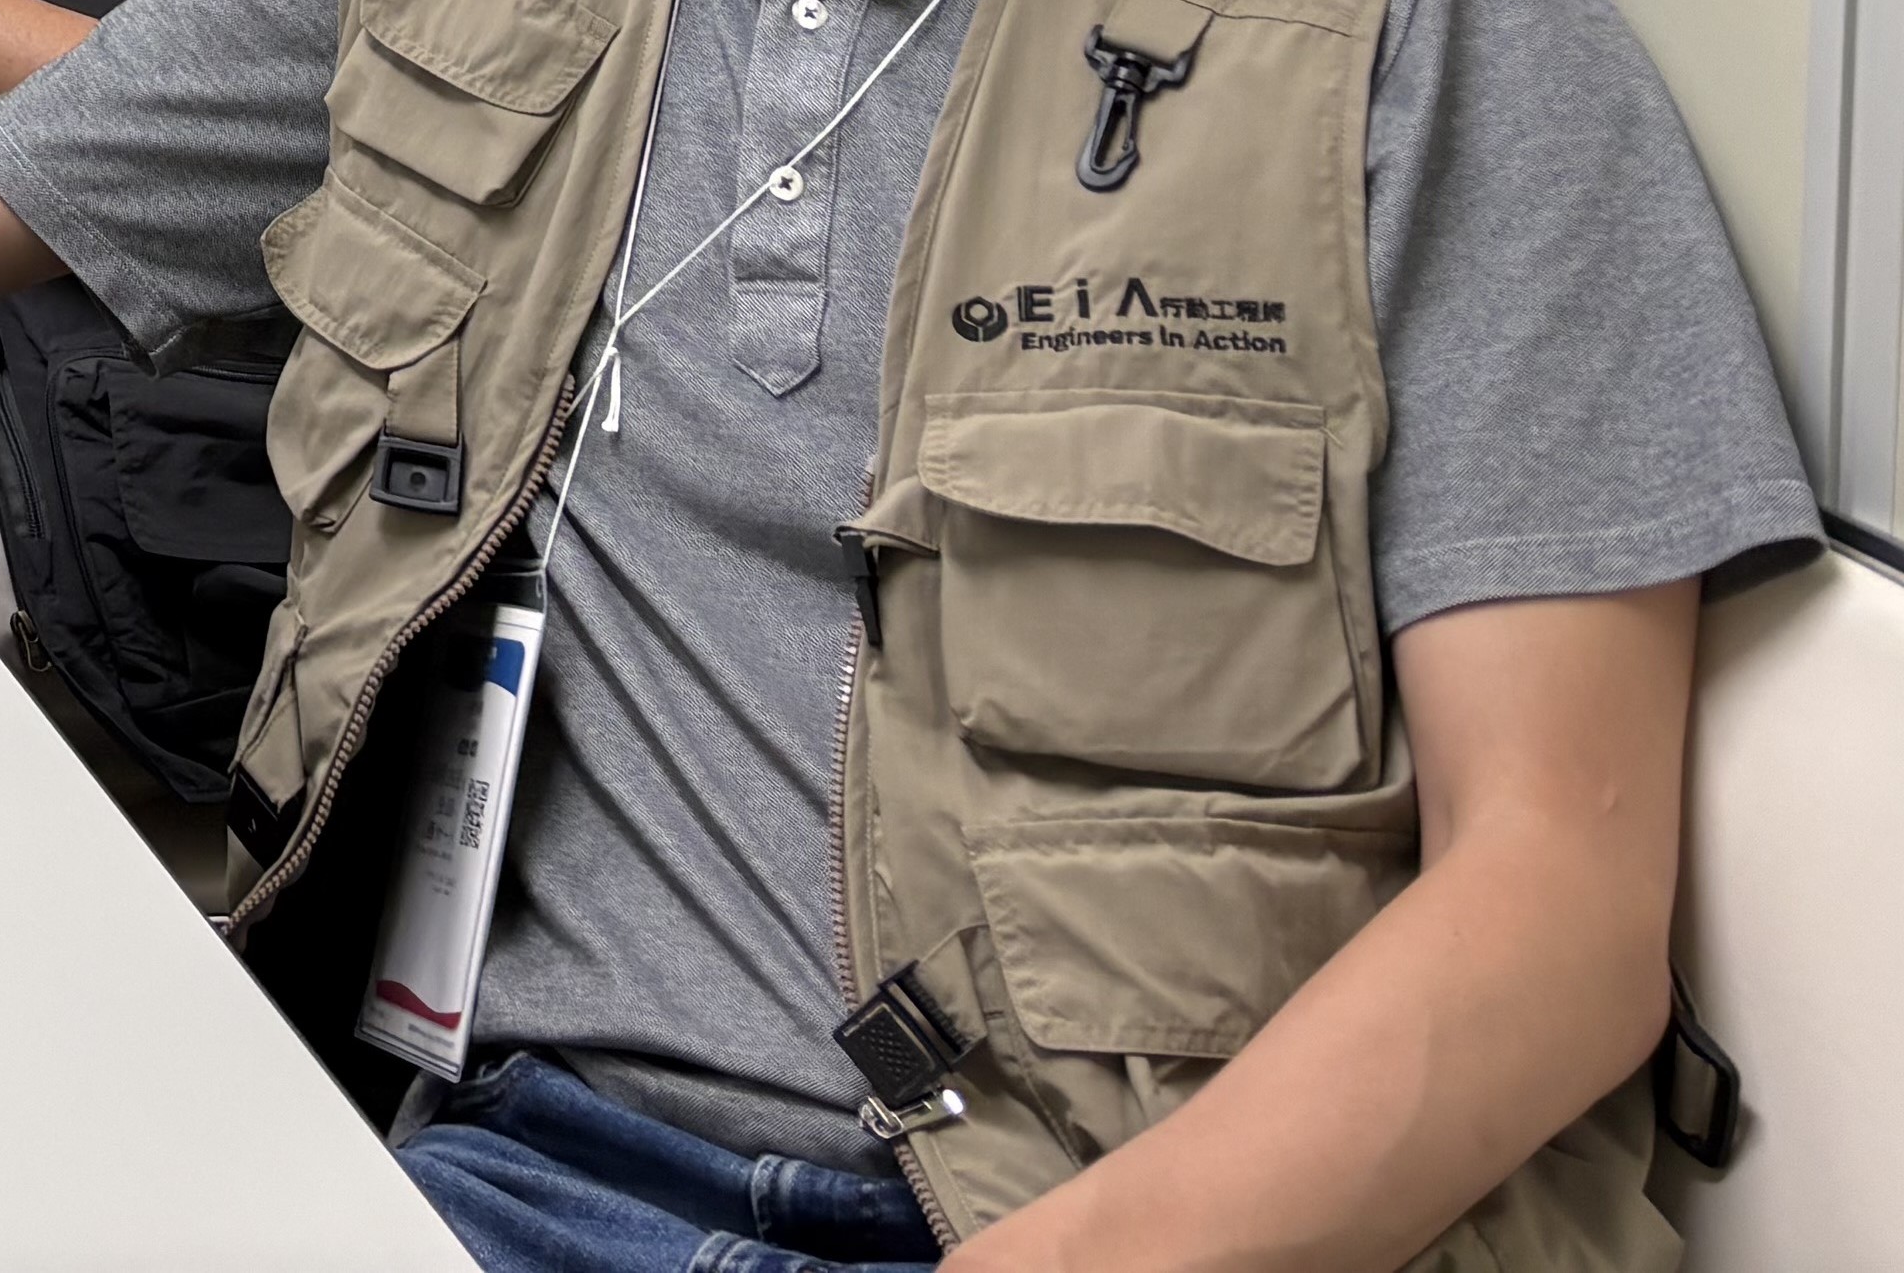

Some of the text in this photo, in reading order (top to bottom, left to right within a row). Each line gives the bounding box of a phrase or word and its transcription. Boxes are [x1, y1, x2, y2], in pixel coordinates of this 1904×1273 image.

[1020, 324, 1287, 354] Engineers In Action
